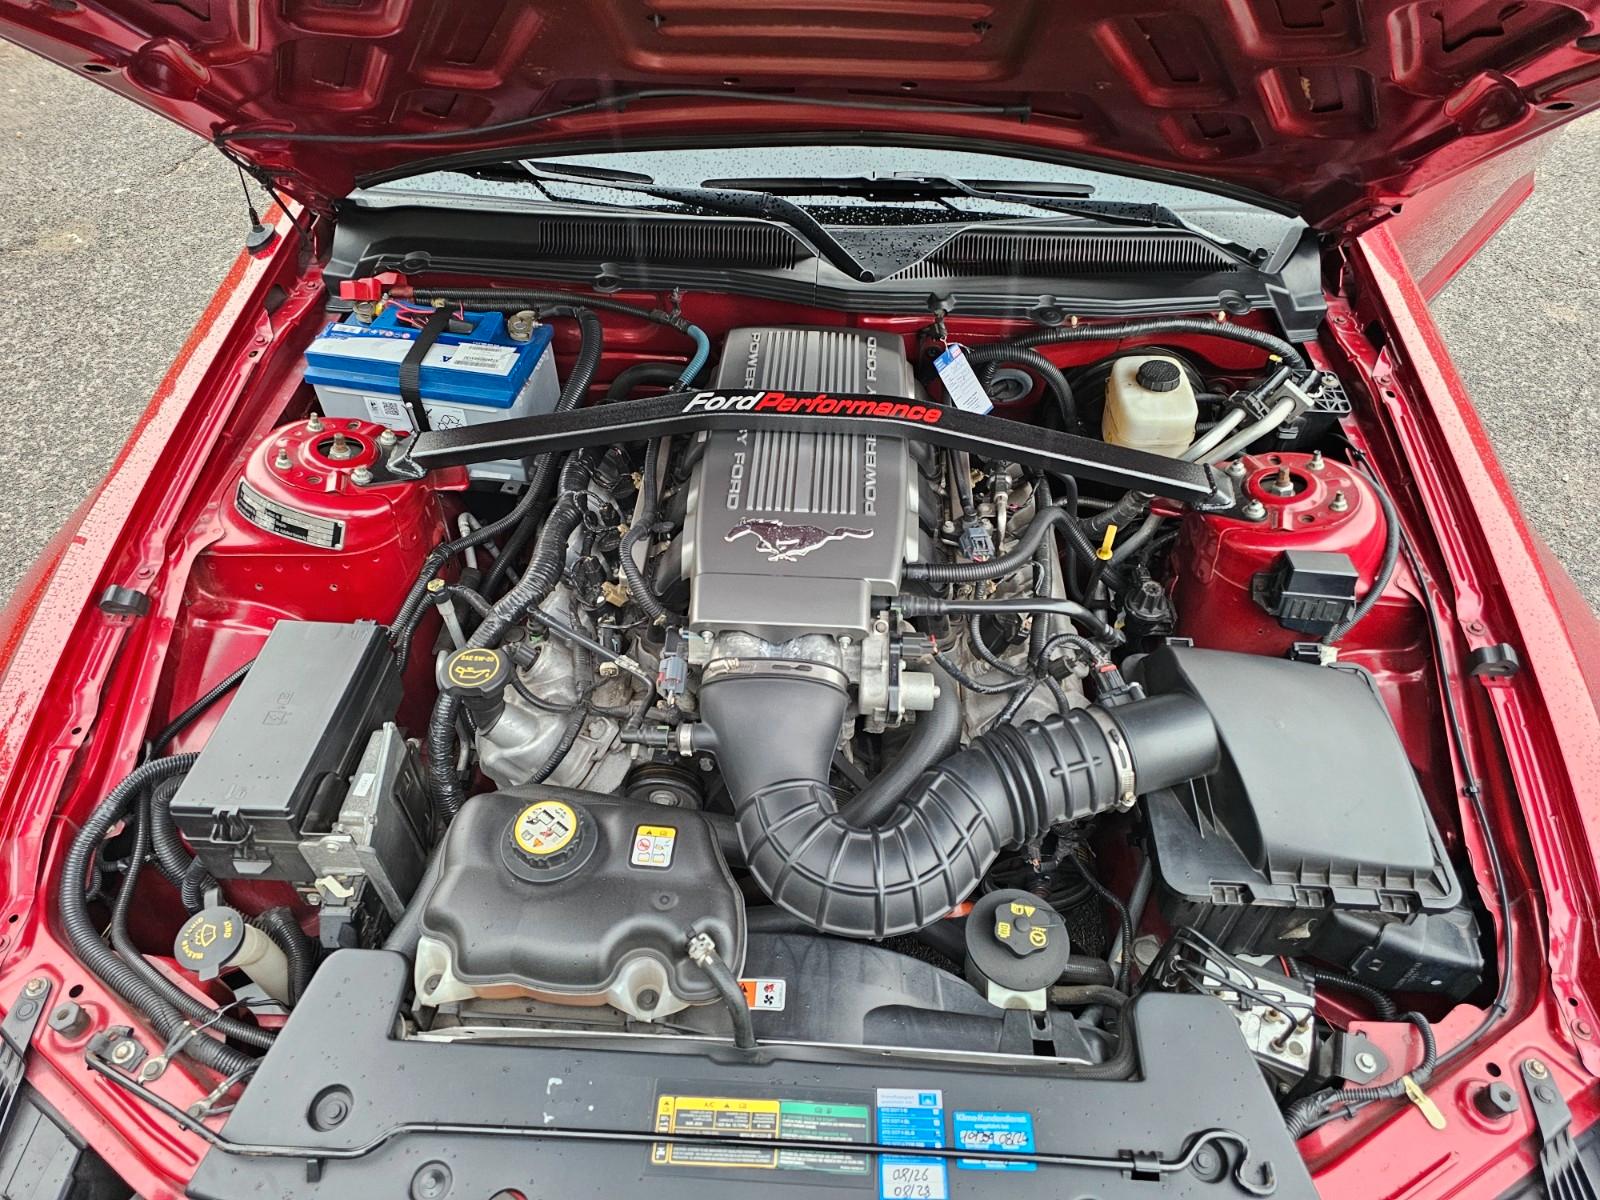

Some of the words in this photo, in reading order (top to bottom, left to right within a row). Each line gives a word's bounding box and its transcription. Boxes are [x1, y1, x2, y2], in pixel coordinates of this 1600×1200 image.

[743, 331, 761, 390] POWER
[866, 336, 877, 382] FORD
[726, 452, 744, 510] FORD
[892, 1167, 929, 1183] 08/26
